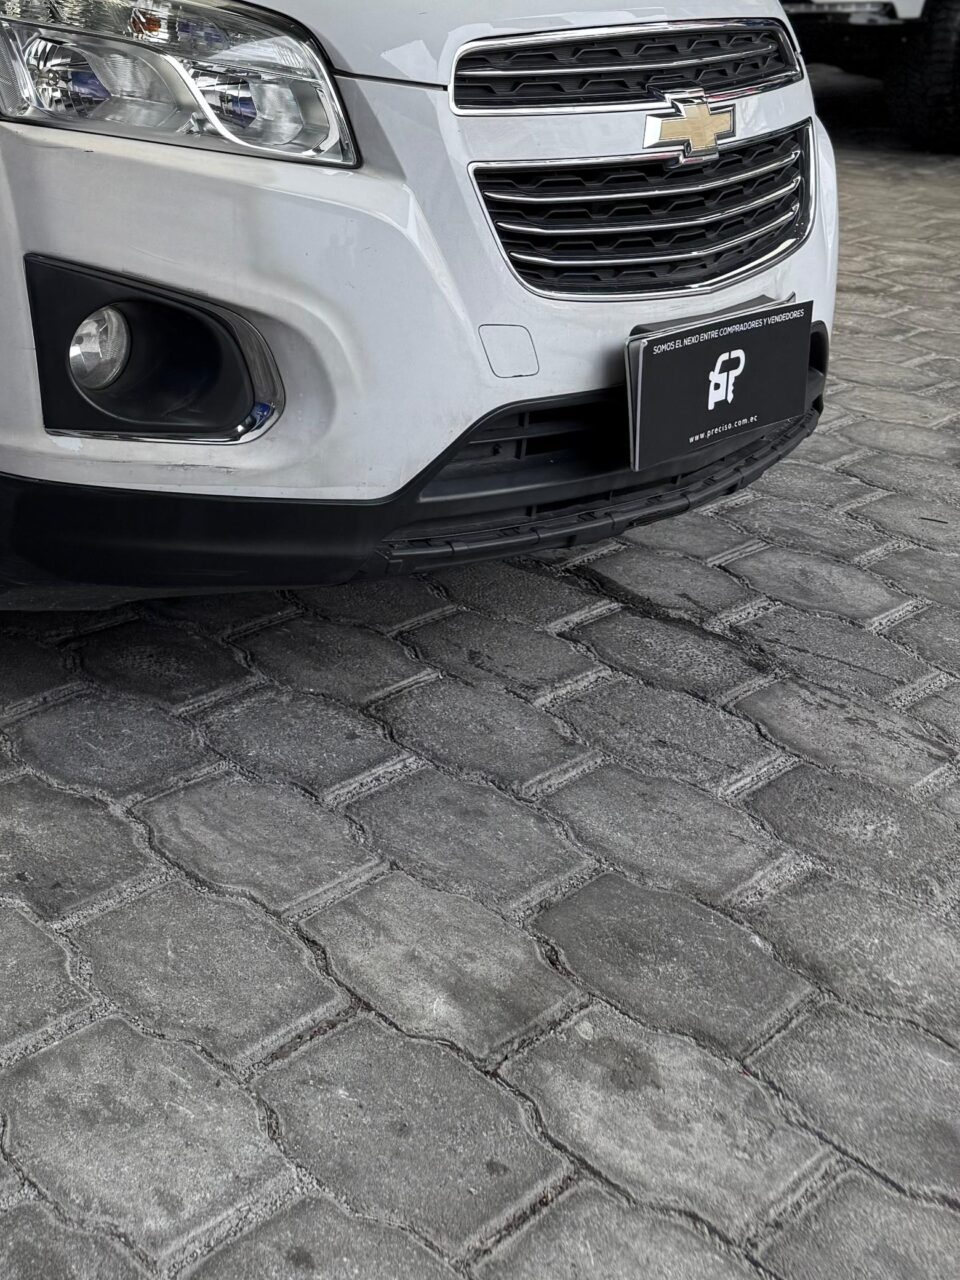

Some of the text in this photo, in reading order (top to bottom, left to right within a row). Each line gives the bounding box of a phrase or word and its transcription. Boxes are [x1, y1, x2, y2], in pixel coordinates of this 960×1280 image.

[653, 341, 675, 355] SOMOS
[675, 339, 683, 349] EL
[683, 334, 700, 347] NEXO
[700, 329, 719, 342] ENTRE
[719, 318, 763, 337] COMPRADORES
[767, 308, 805, 325] VENDEDORES
[688, 415, 758, 443] www.preciso.com.ec
